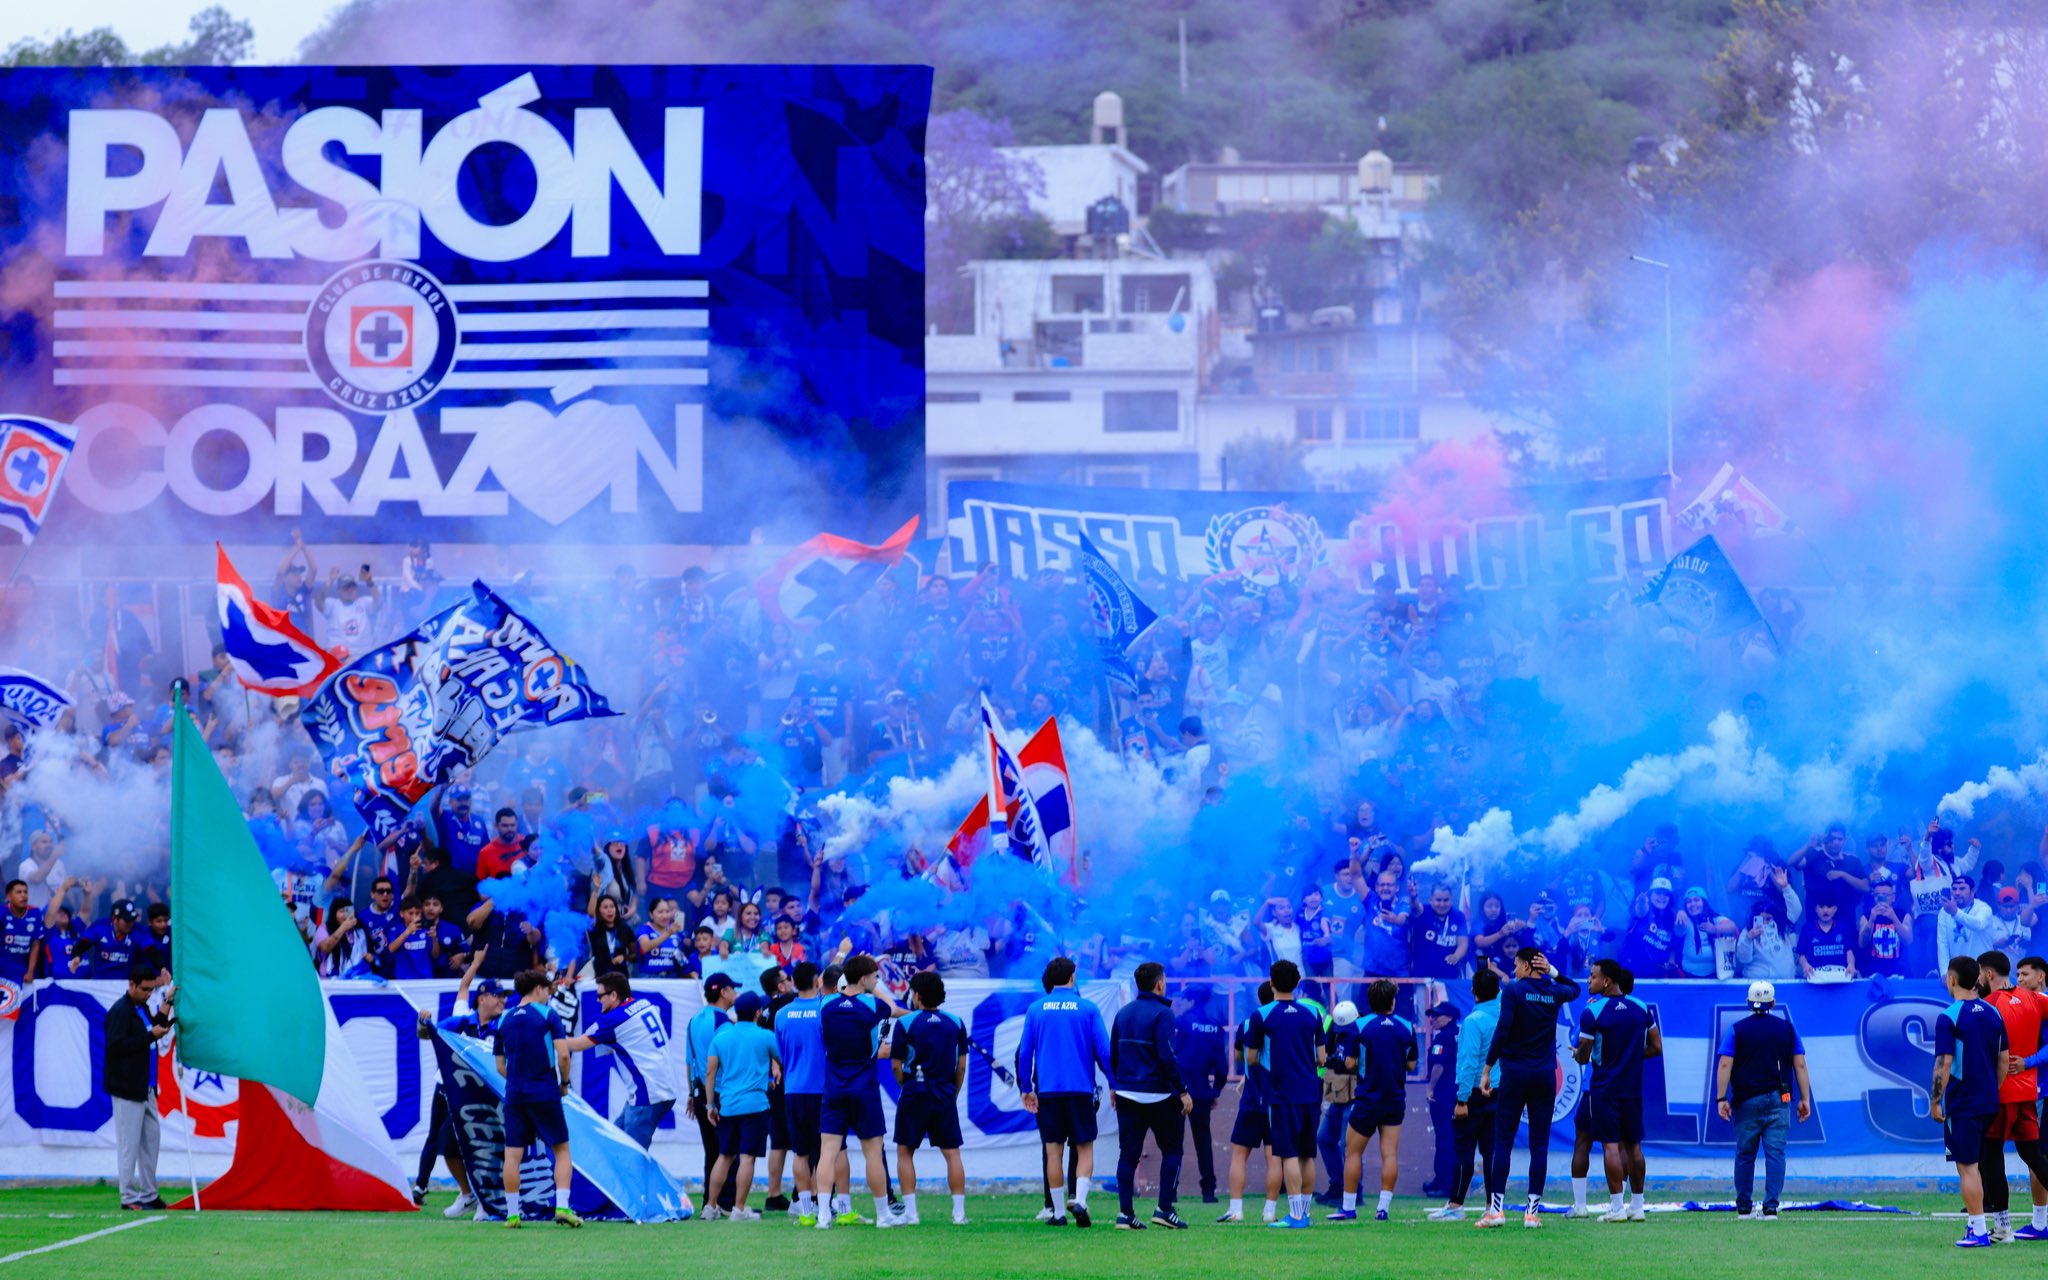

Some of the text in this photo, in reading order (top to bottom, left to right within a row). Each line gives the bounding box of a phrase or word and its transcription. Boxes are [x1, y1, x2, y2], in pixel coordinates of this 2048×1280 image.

[65, 72, 704, 262] PASIÓN
[318, 267, 445, 313] CLUB DE FUTBOL
[329, 377, 434, 409] CRUZ AZUL
[948, 498, 1188, 583] JASSO
[787, 1009, 817, 1019] CRUZ AZUL
[1043, 1001, 1079, 1011] CRUZ AZUL
[1526, 992, 1555, 1004] CRUZ AZUL
[641, 1011, 666, 1049] 9
